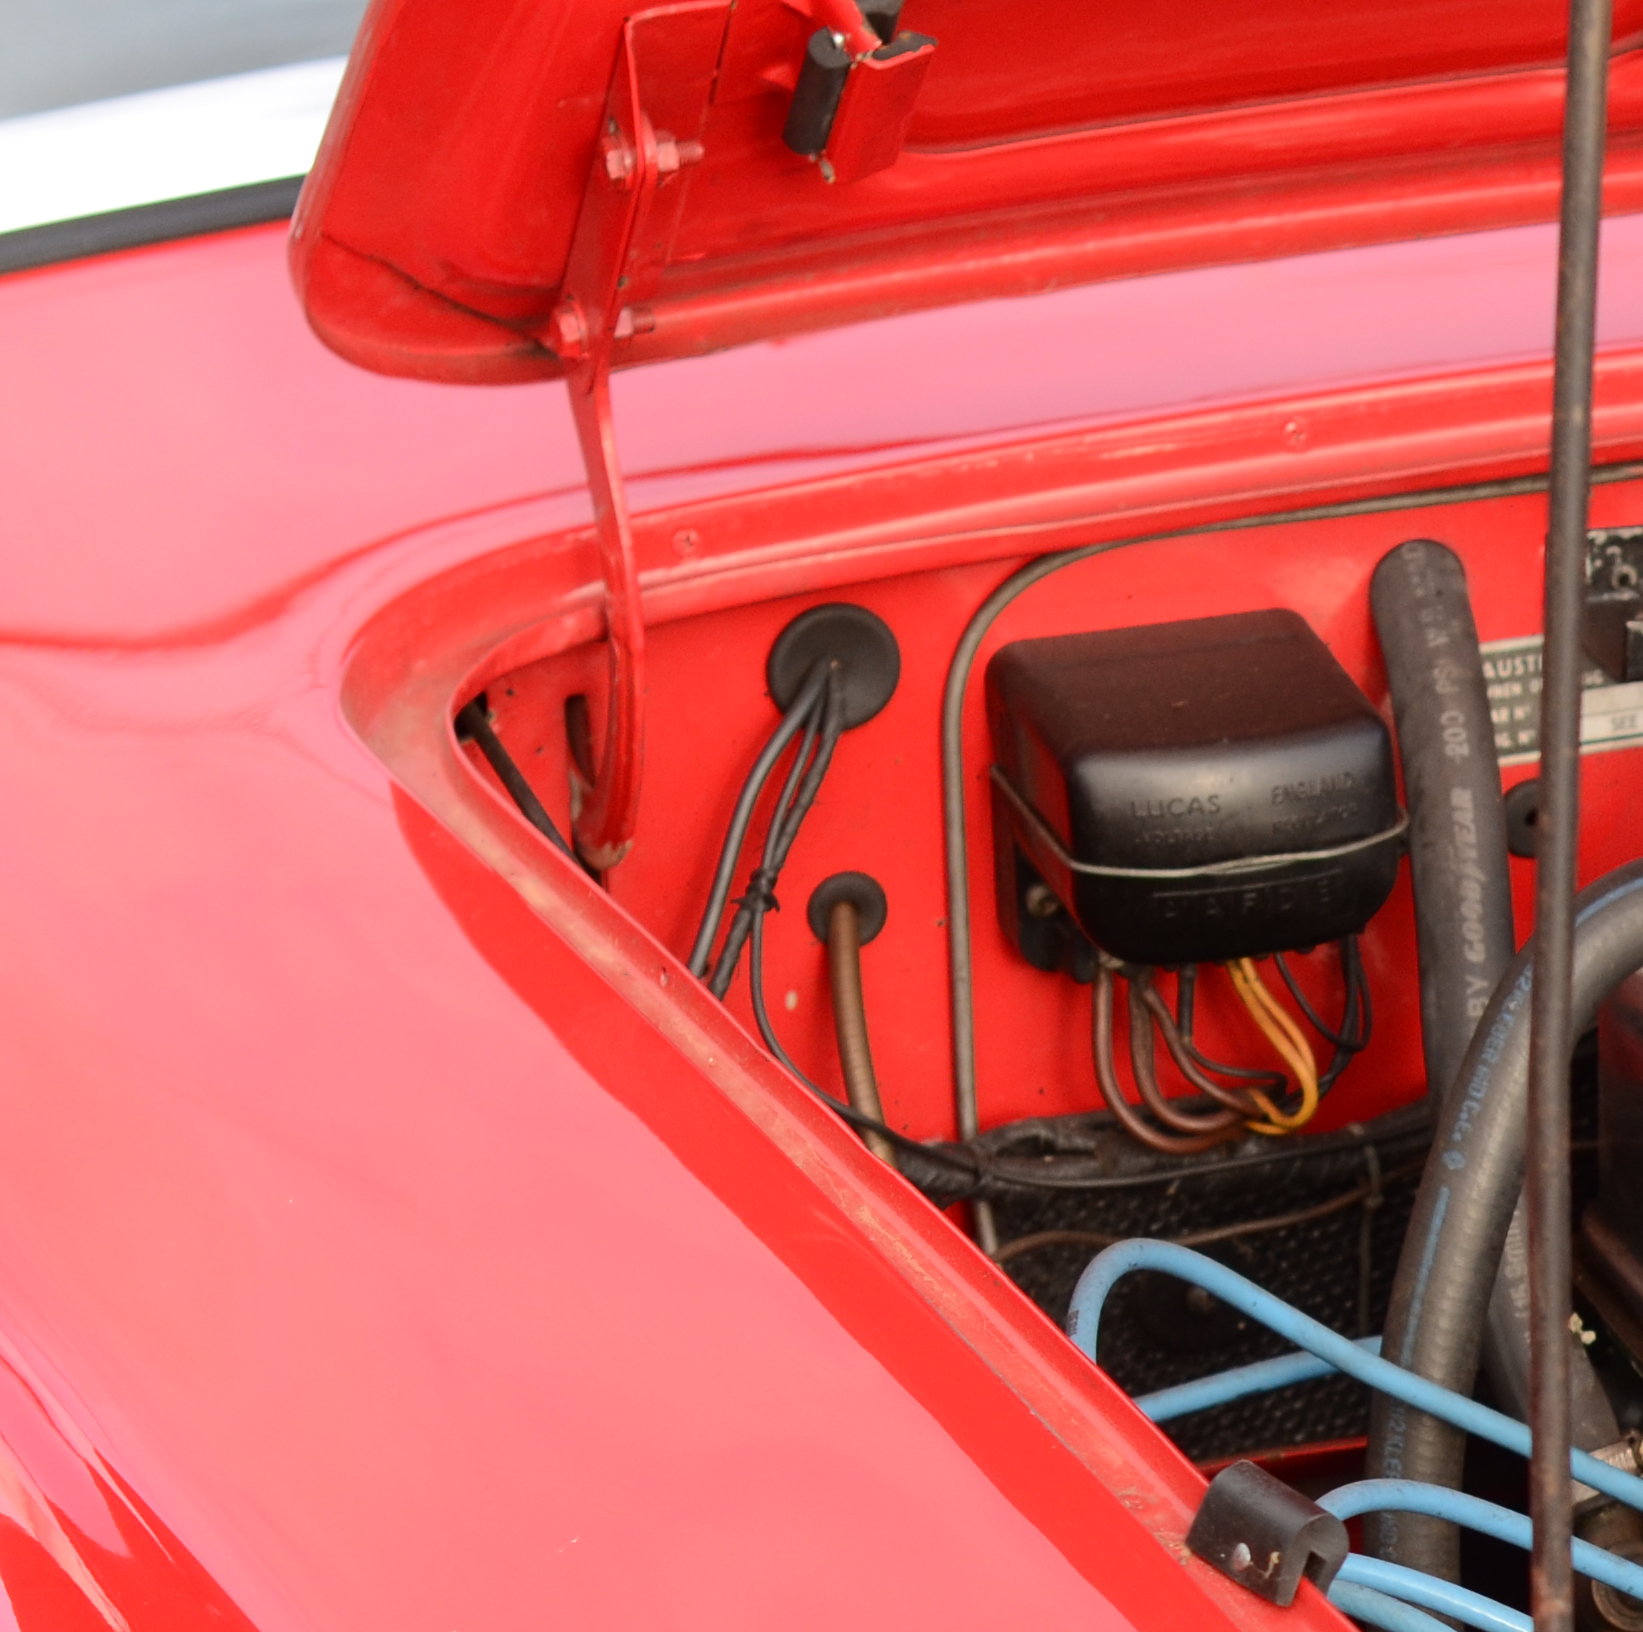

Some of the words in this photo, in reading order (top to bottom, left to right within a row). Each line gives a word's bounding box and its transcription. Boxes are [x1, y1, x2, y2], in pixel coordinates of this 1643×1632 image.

[1611, 715, 1637, 731] SEE
[1131, 794, 1221, 819] LUCAS
[1452, 787, 1487, 964] GOODYEAR
